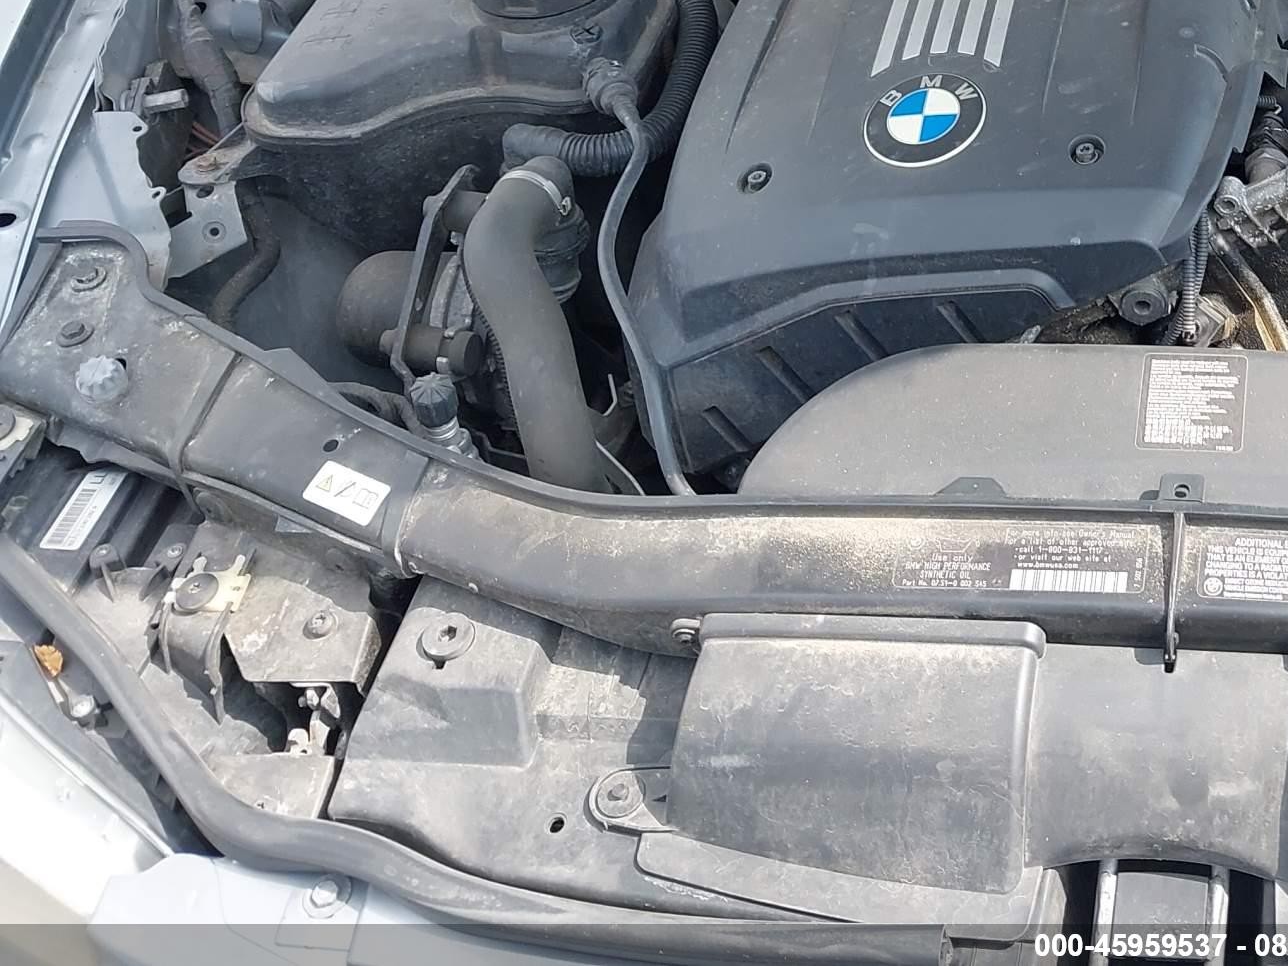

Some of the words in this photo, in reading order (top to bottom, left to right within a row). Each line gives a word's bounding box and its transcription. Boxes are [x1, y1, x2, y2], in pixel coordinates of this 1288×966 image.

[880, 75, 978, 107] BMW
[1109, 529, 1136, 539] Manual
[1235, 538, 1283, 548] ADDITIONAL
[1207, 545, 1224, 554] THIS
[1225, 546, 1256, 555] VEHICLE
[1256, 547, 1263, 556] IS
[932, 553, 948, 561] Use
[953, 554, 973, 563] only
[1067, 554, 1081, 562] web
[1103, 555, 1111, 563] at
[1207, 553, 1225, 562] THAT
[1226, 554, 1234, 562] IS
[1235, 554, 1245, 563] AN
[1246, 555, 1280, 564] ELEMENT
[905, 562, 920, 570] BMW
[924, 562, 941, 570] HIGH
[943, 562, 992, 571] PERFORMANCE
[1244, 562, 1254, 571] TO
[920, 570, 955, 579] SYNTHETIC
[960, 571, 971, 579] OIL
[1205, 568, 1248, 579] PROPERTIES
[1249, 570, 1256, 579] IS
[902, 578, 915, 586] Part
